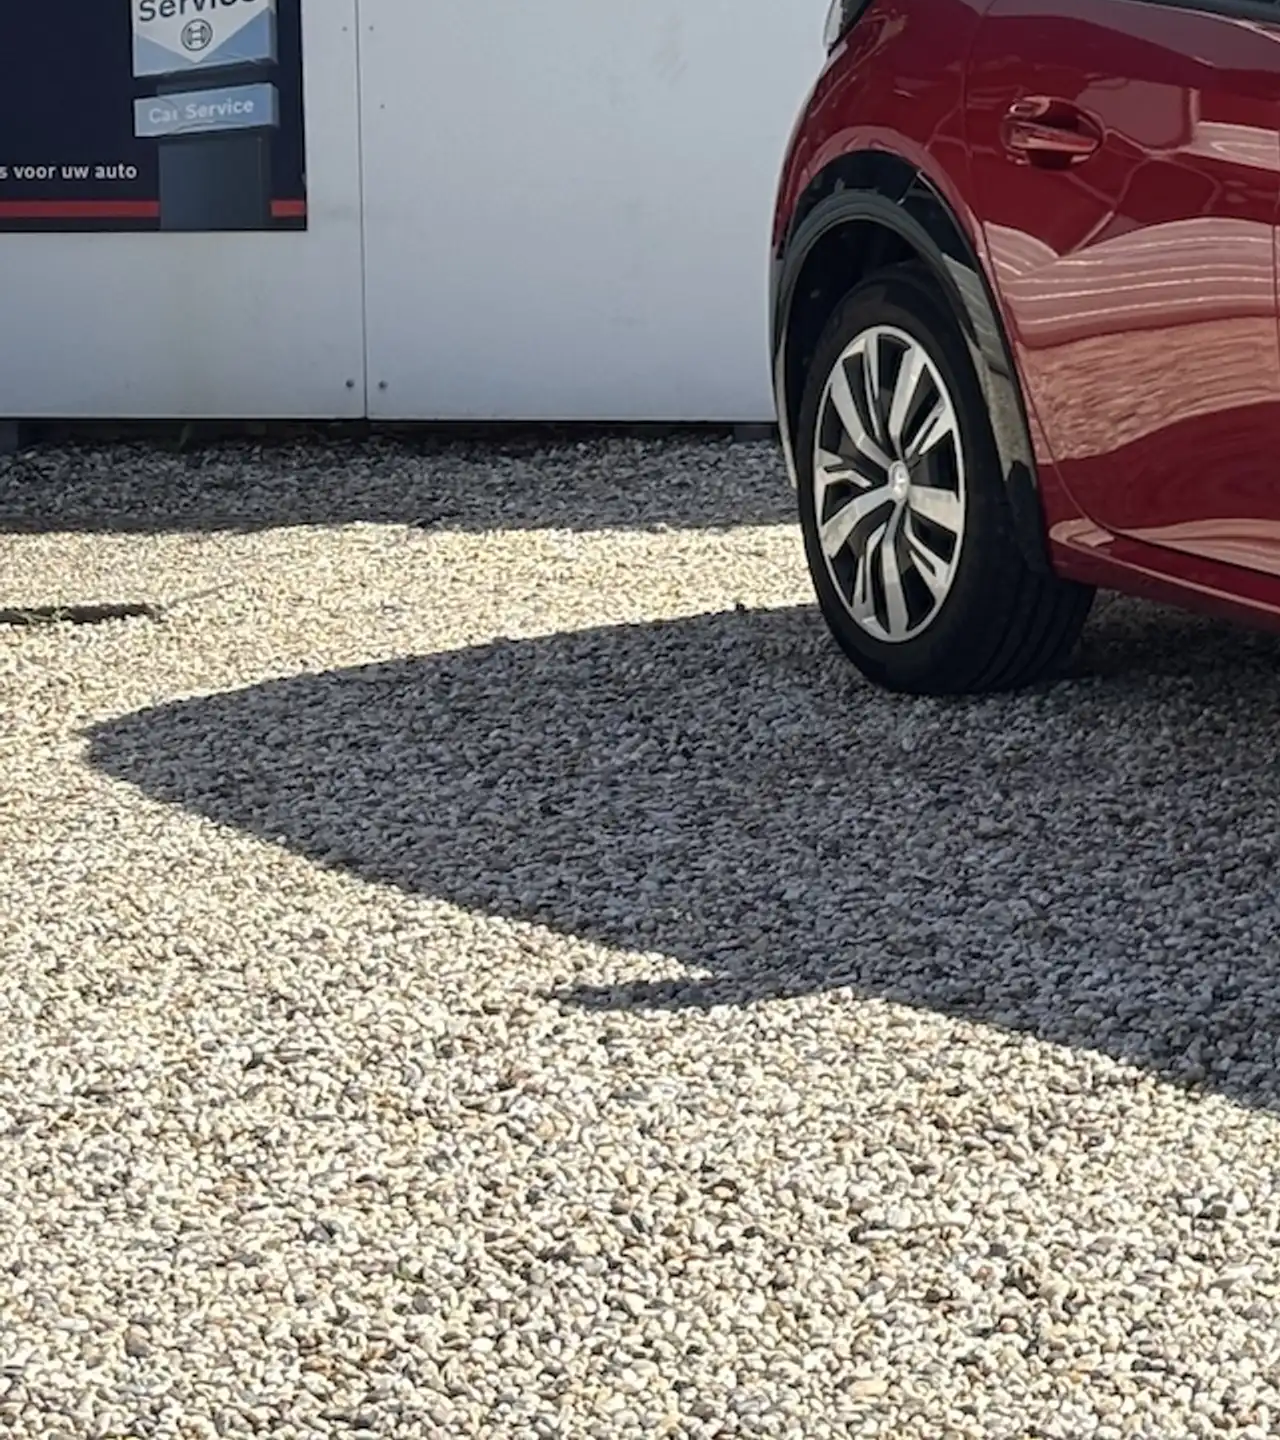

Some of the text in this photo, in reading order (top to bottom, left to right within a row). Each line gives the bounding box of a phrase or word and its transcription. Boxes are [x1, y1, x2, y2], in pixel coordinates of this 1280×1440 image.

[149, 98, 254, 123] Car Service
[13, 166, 56, 179] voor
[61, 166, 89, 179] uw
[95, 163, 138, 179] auto
